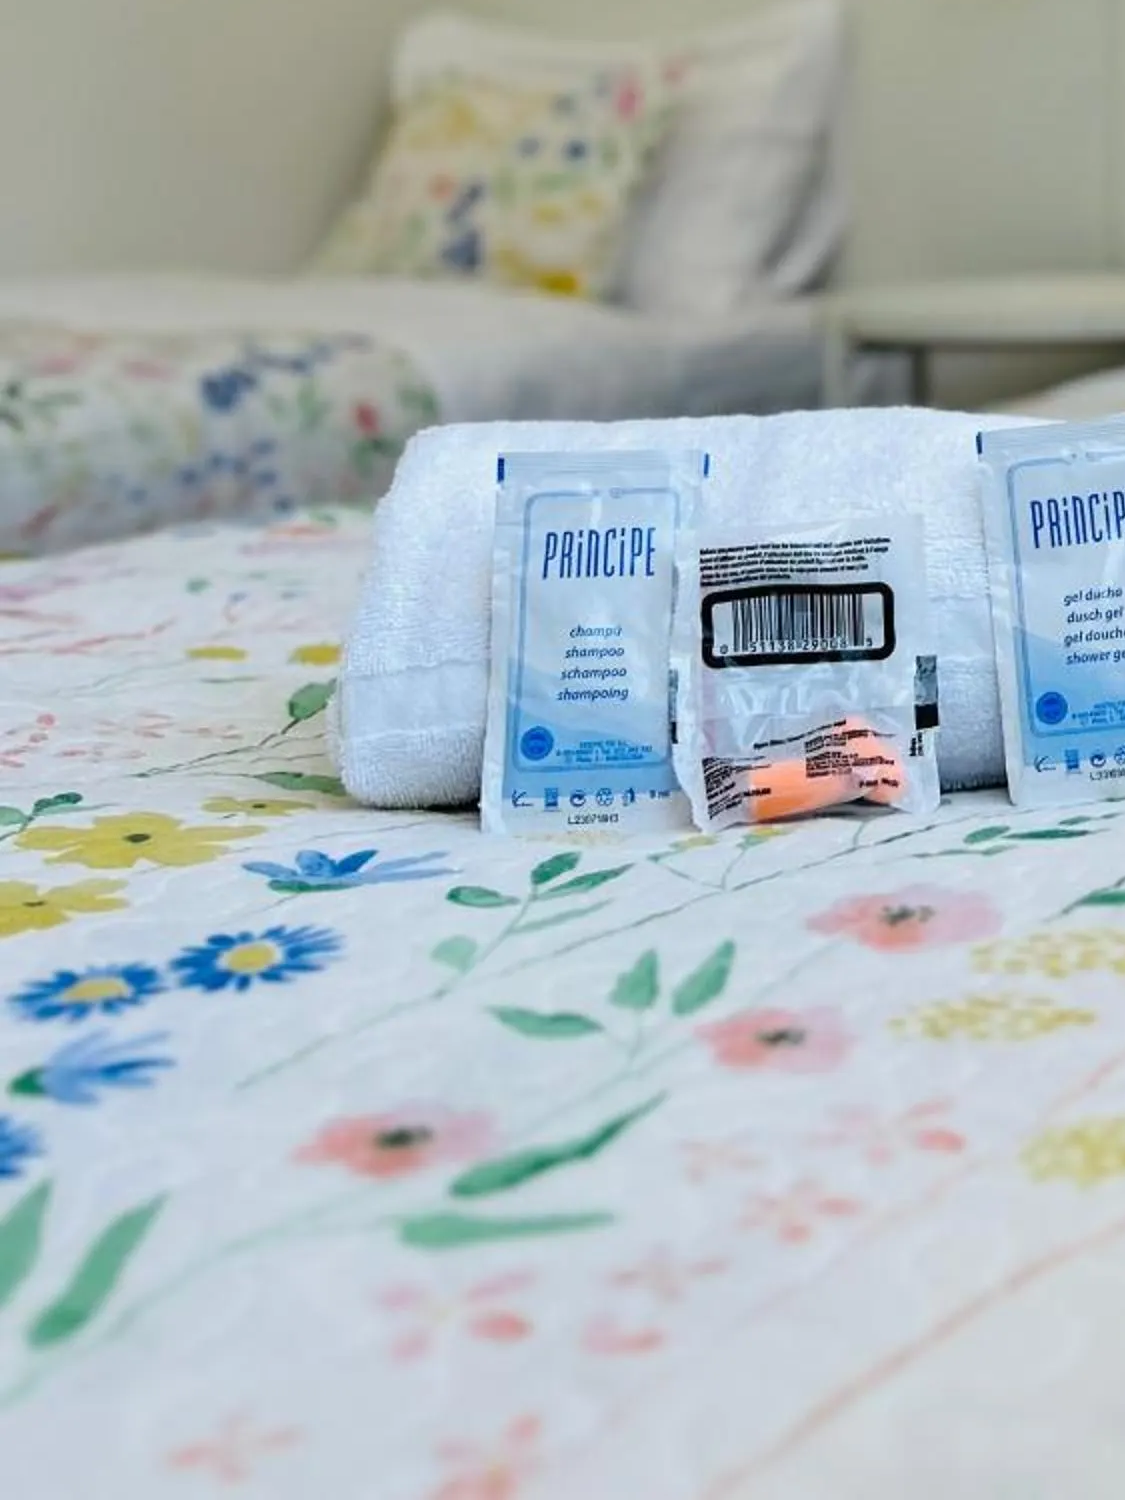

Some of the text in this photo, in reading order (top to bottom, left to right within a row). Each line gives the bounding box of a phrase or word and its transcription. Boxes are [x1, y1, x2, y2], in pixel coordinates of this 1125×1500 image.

[1063, 586, 1123, 607] gel ducha
[1067, 606, 1124, 623] dusch gel
[1063, 630, 1083, 648] gel
[565, 645, 625, 659] shampoo
[1066, 652, 1111, 665] shower
[561, 666, 627, 681] schampoo
[557, 687, 629, 702] shampoing
